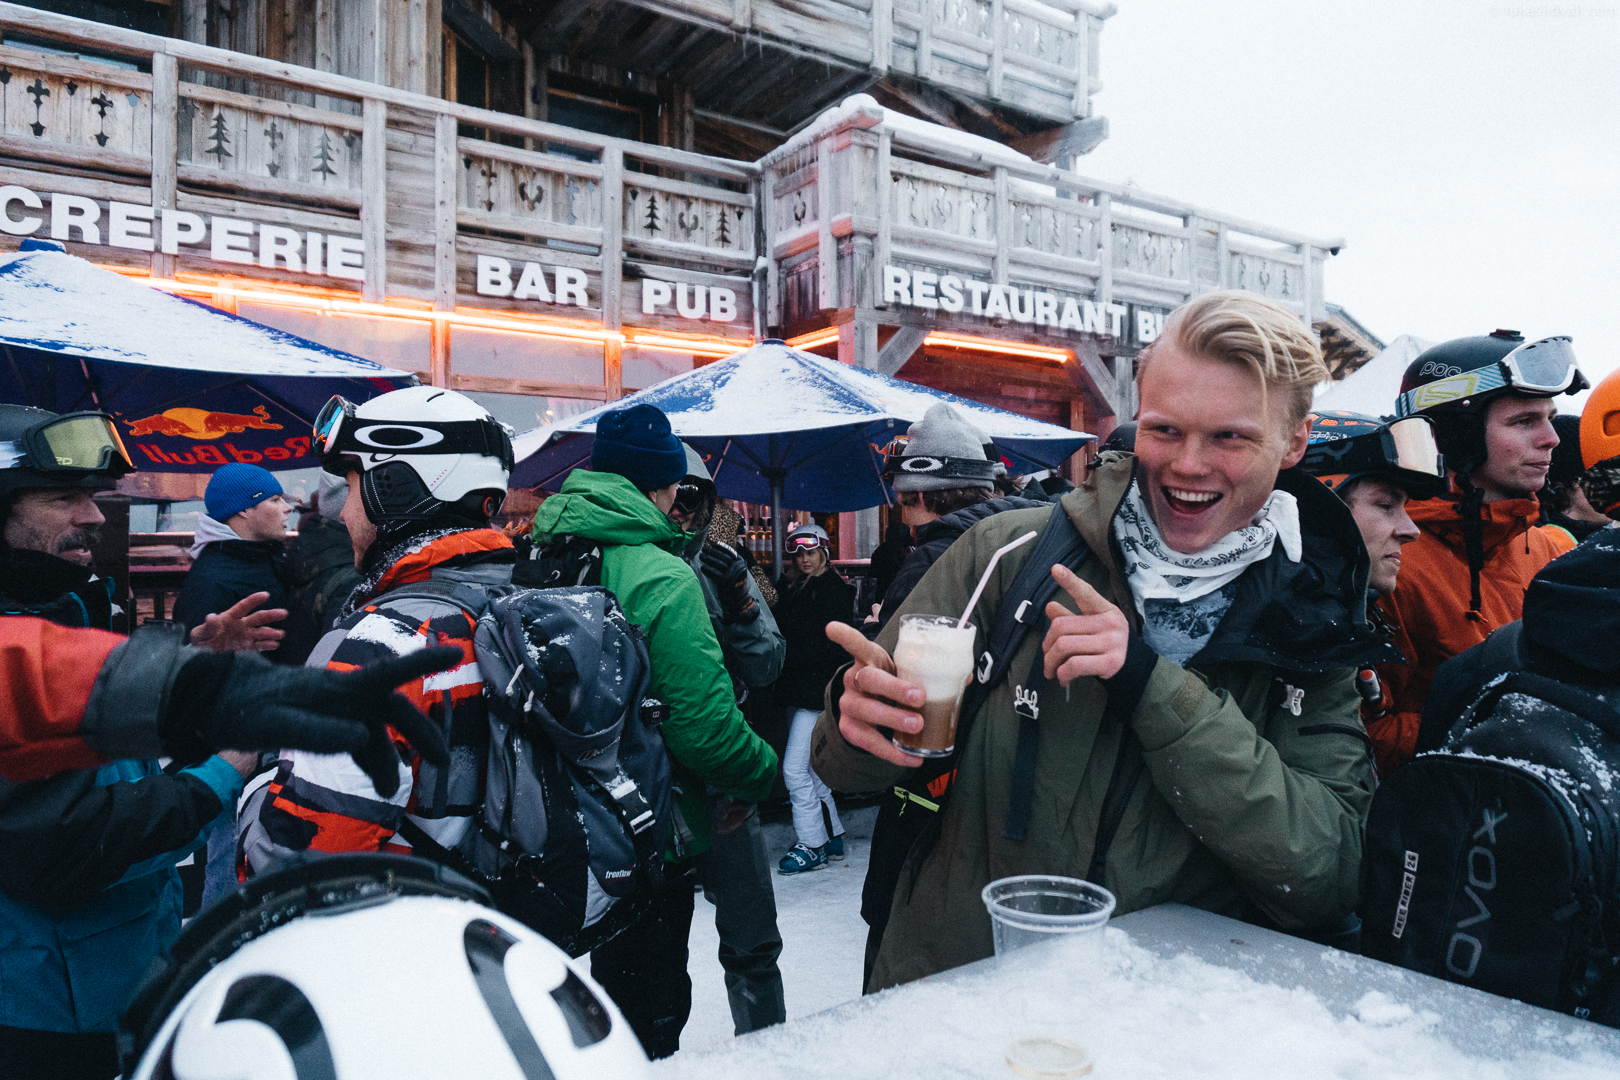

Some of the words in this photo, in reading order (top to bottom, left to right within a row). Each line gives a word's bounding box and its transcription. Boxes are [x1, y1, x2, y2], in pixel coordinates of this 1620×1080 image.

[0, 185, 365, 281] CREPERIE
[476, 254, 588, 307] BAR
[642, 278, 737, 322] PUB
[883, 264, 1127, 337] RESTAURANT
